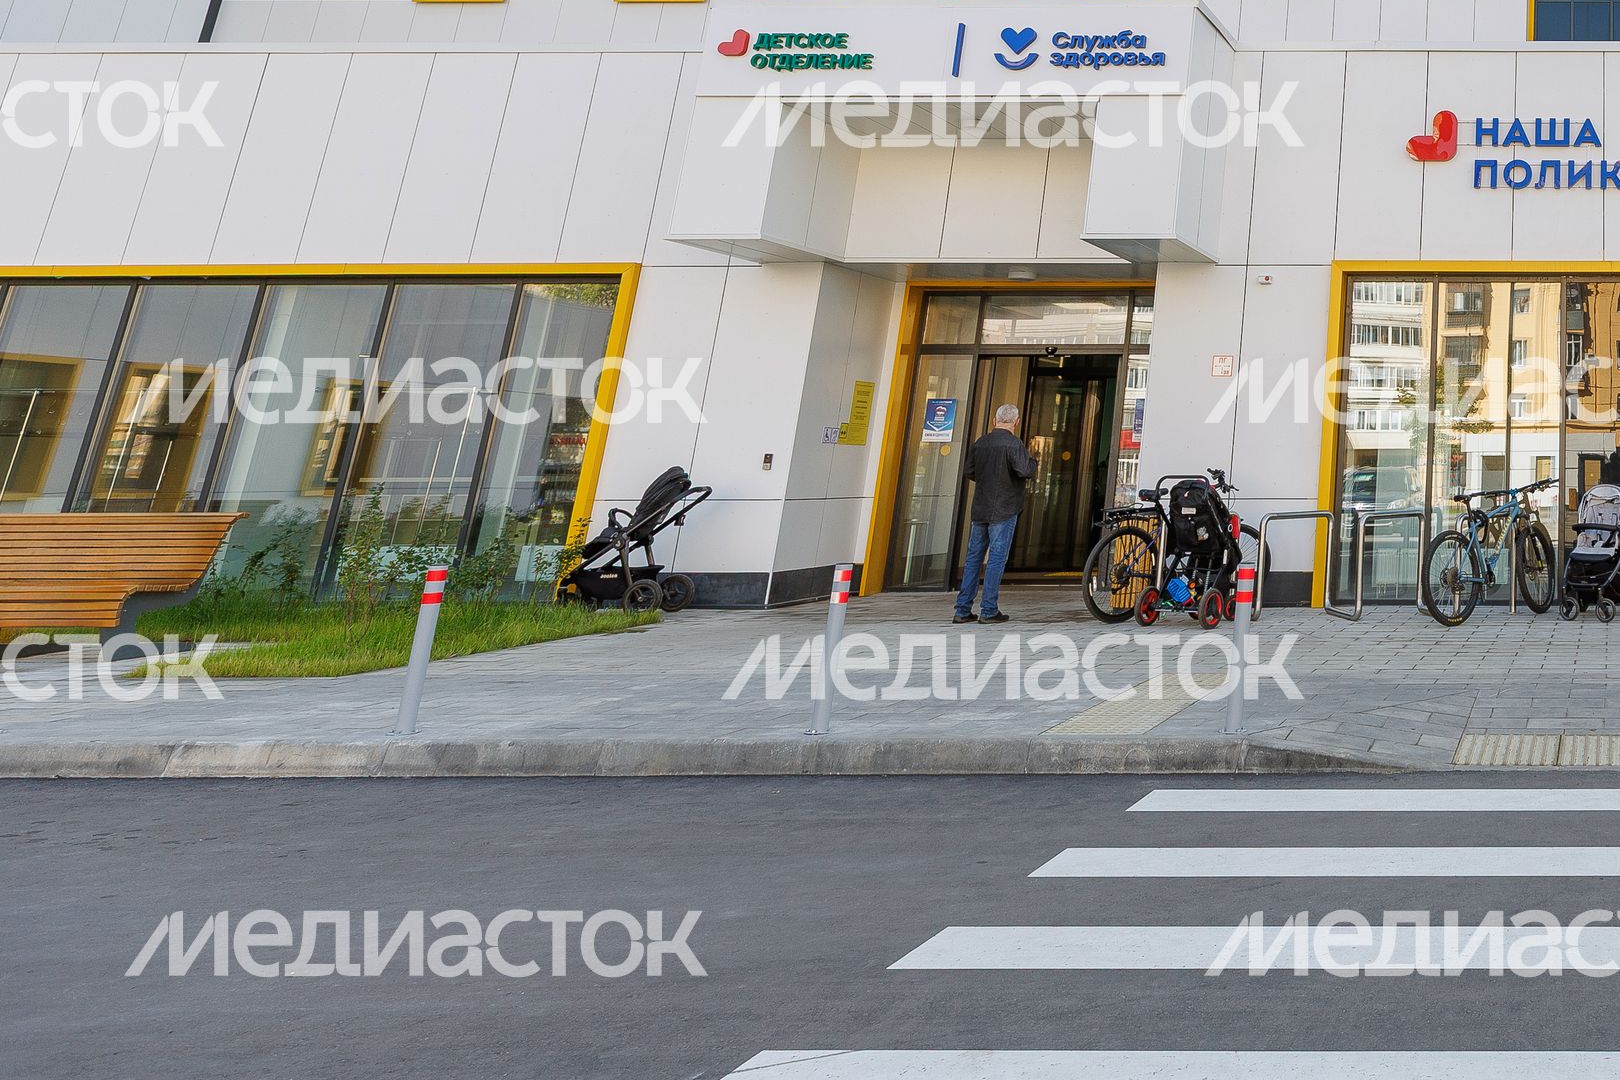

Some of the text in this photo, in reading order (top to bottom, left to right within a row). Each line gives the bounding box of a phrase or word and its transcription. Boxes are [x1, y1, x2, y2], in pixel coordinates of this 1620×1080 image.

[753, 32, 850, 51] ДЕТСКОЕ
[1051, 29, 1148, 52] Служба
[750, 53, 875, 72] ОТДЕЛЕНИЕ
[1049, 51, 1166, 70] здоровья
[1475, 117, 1602, 147] НАША
